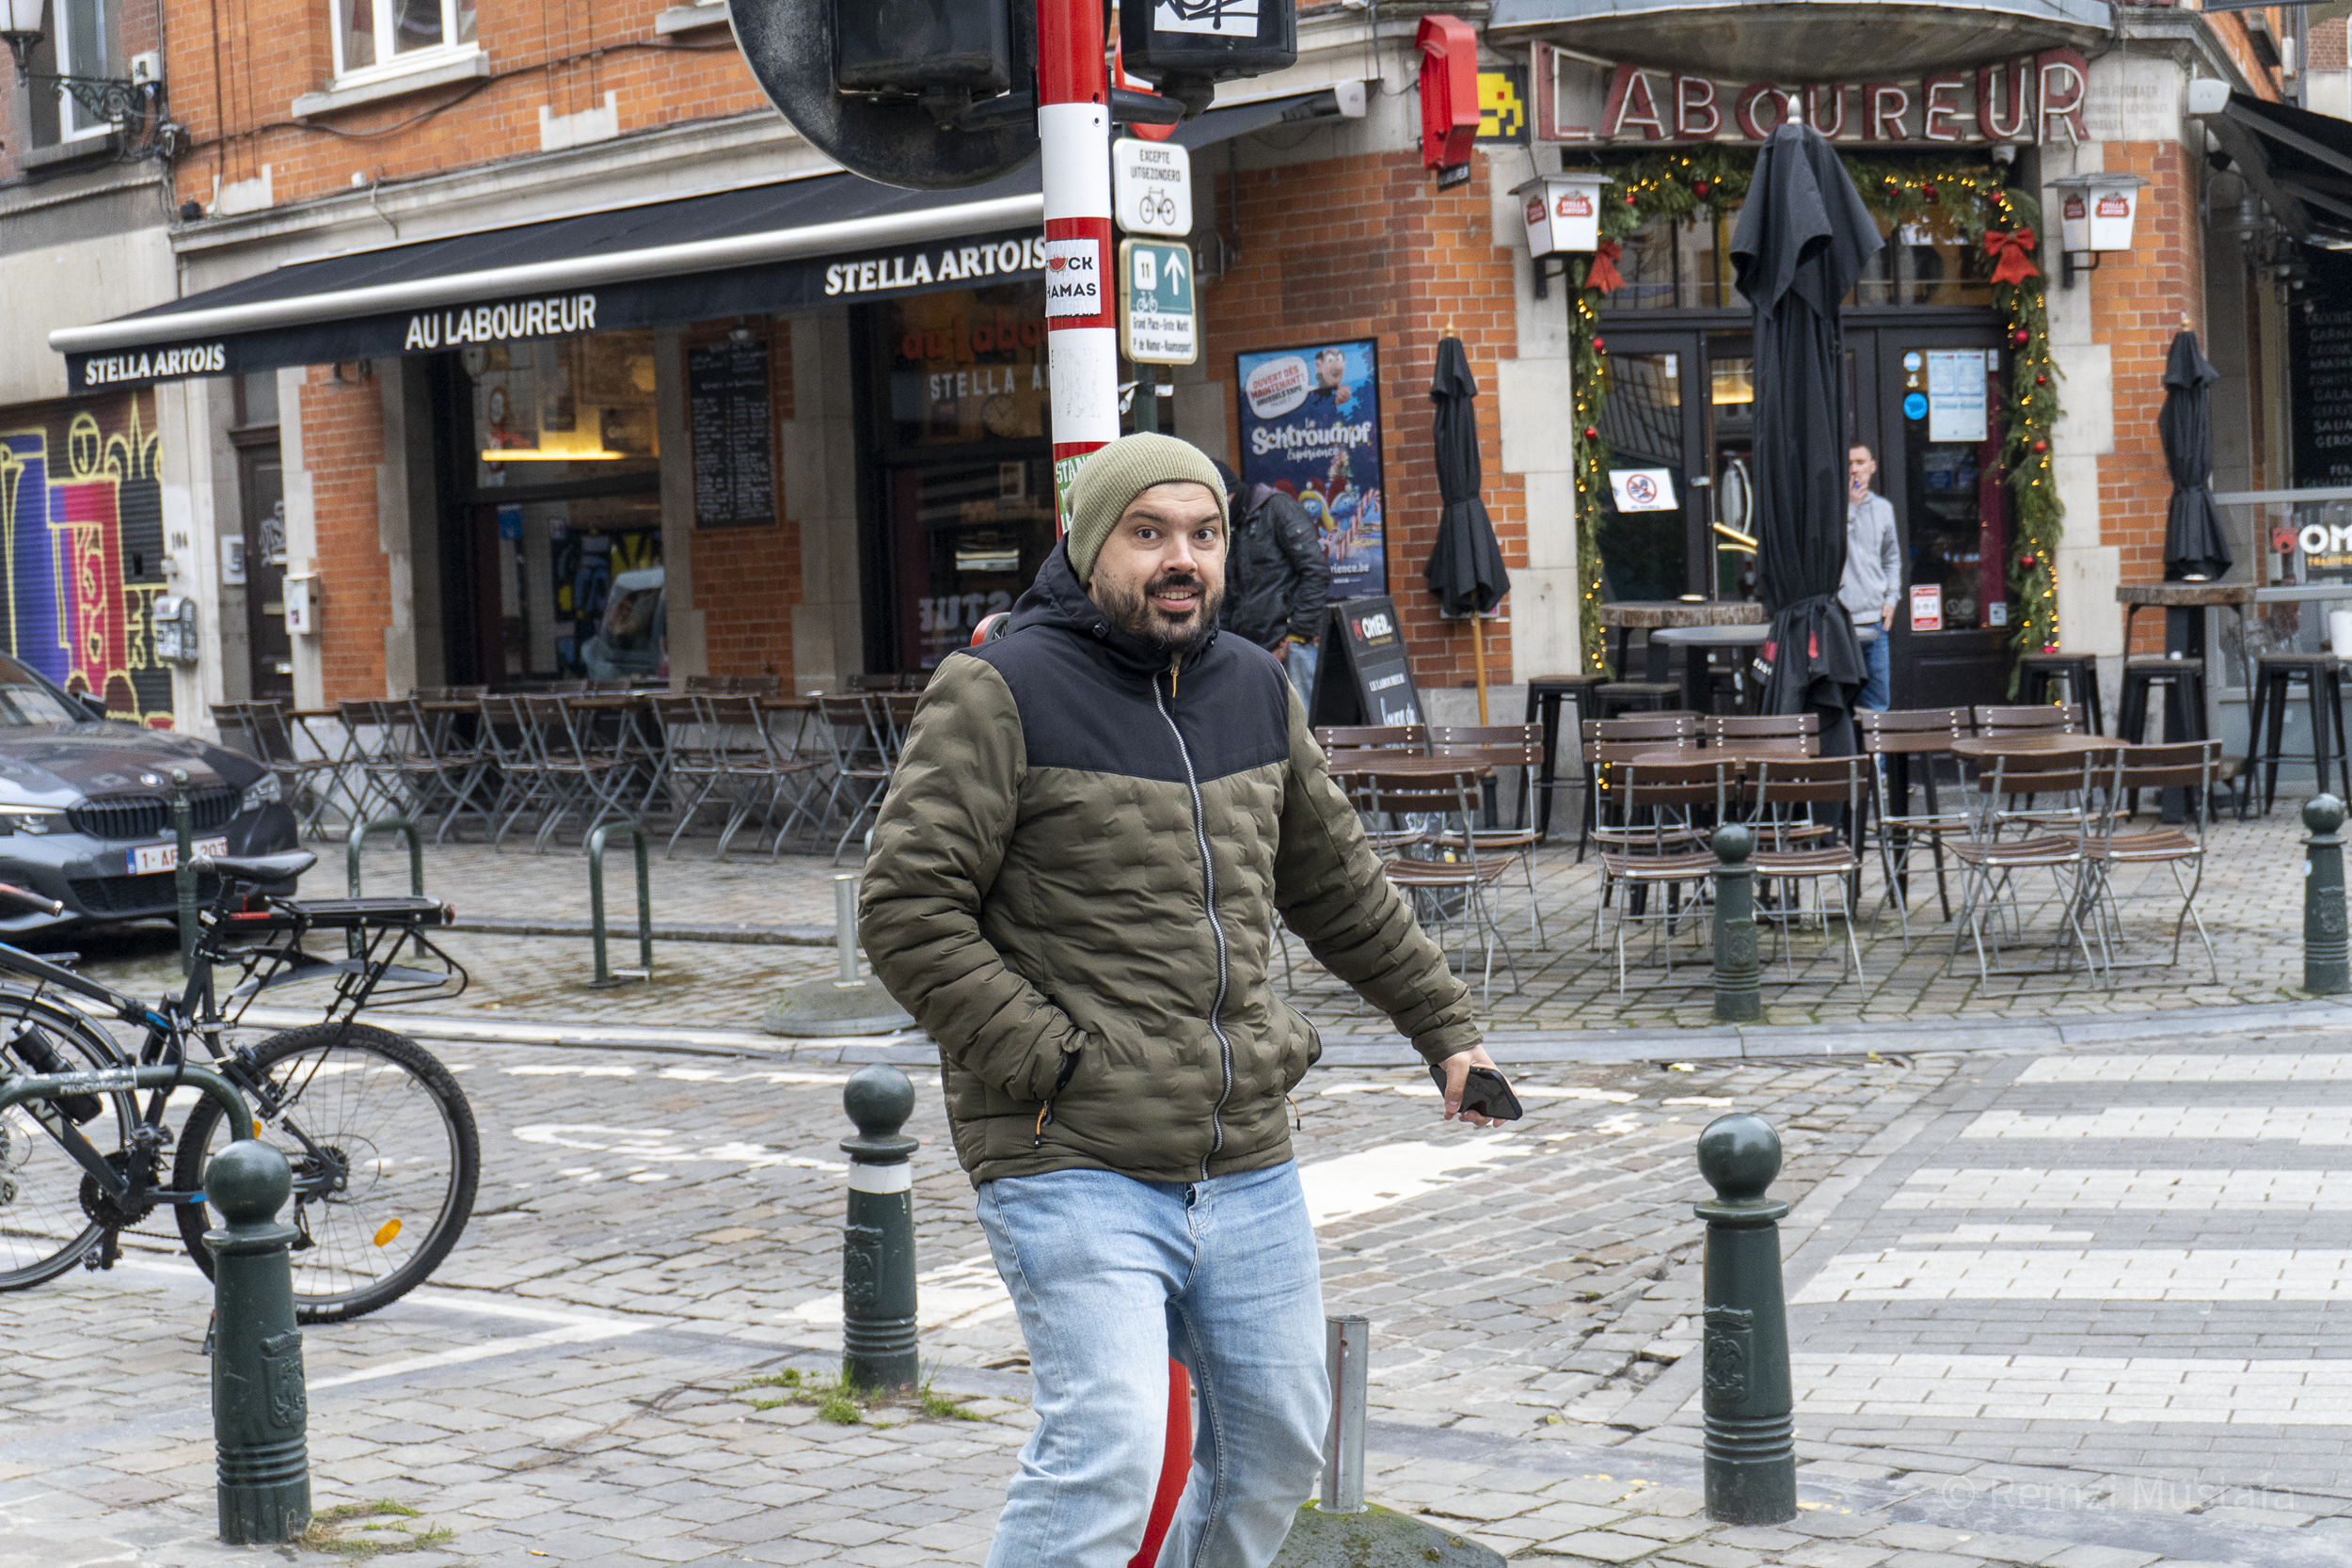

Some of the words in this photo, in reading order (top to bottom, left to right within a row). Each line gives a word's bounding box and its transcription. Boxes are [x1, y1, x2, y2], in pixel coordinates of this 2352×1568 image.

[1532, 40, 2090, 146] LABOUREUR
[825, 254, 933, 295] STELLA
[937, 236, 1045, 282] ARTOIS
[1141, 261, 1151, 279] 11
[405, 313, 439, 350] AU
[445, 293, 596, 345] LABOUREUR
[86, 353, 151, 386] STELLA
[152, 343, 226, 376] ARTOIS
[930, 367, 1015, 400] STELLA
[1251, 420, 1372, 455] Schtroumpf
